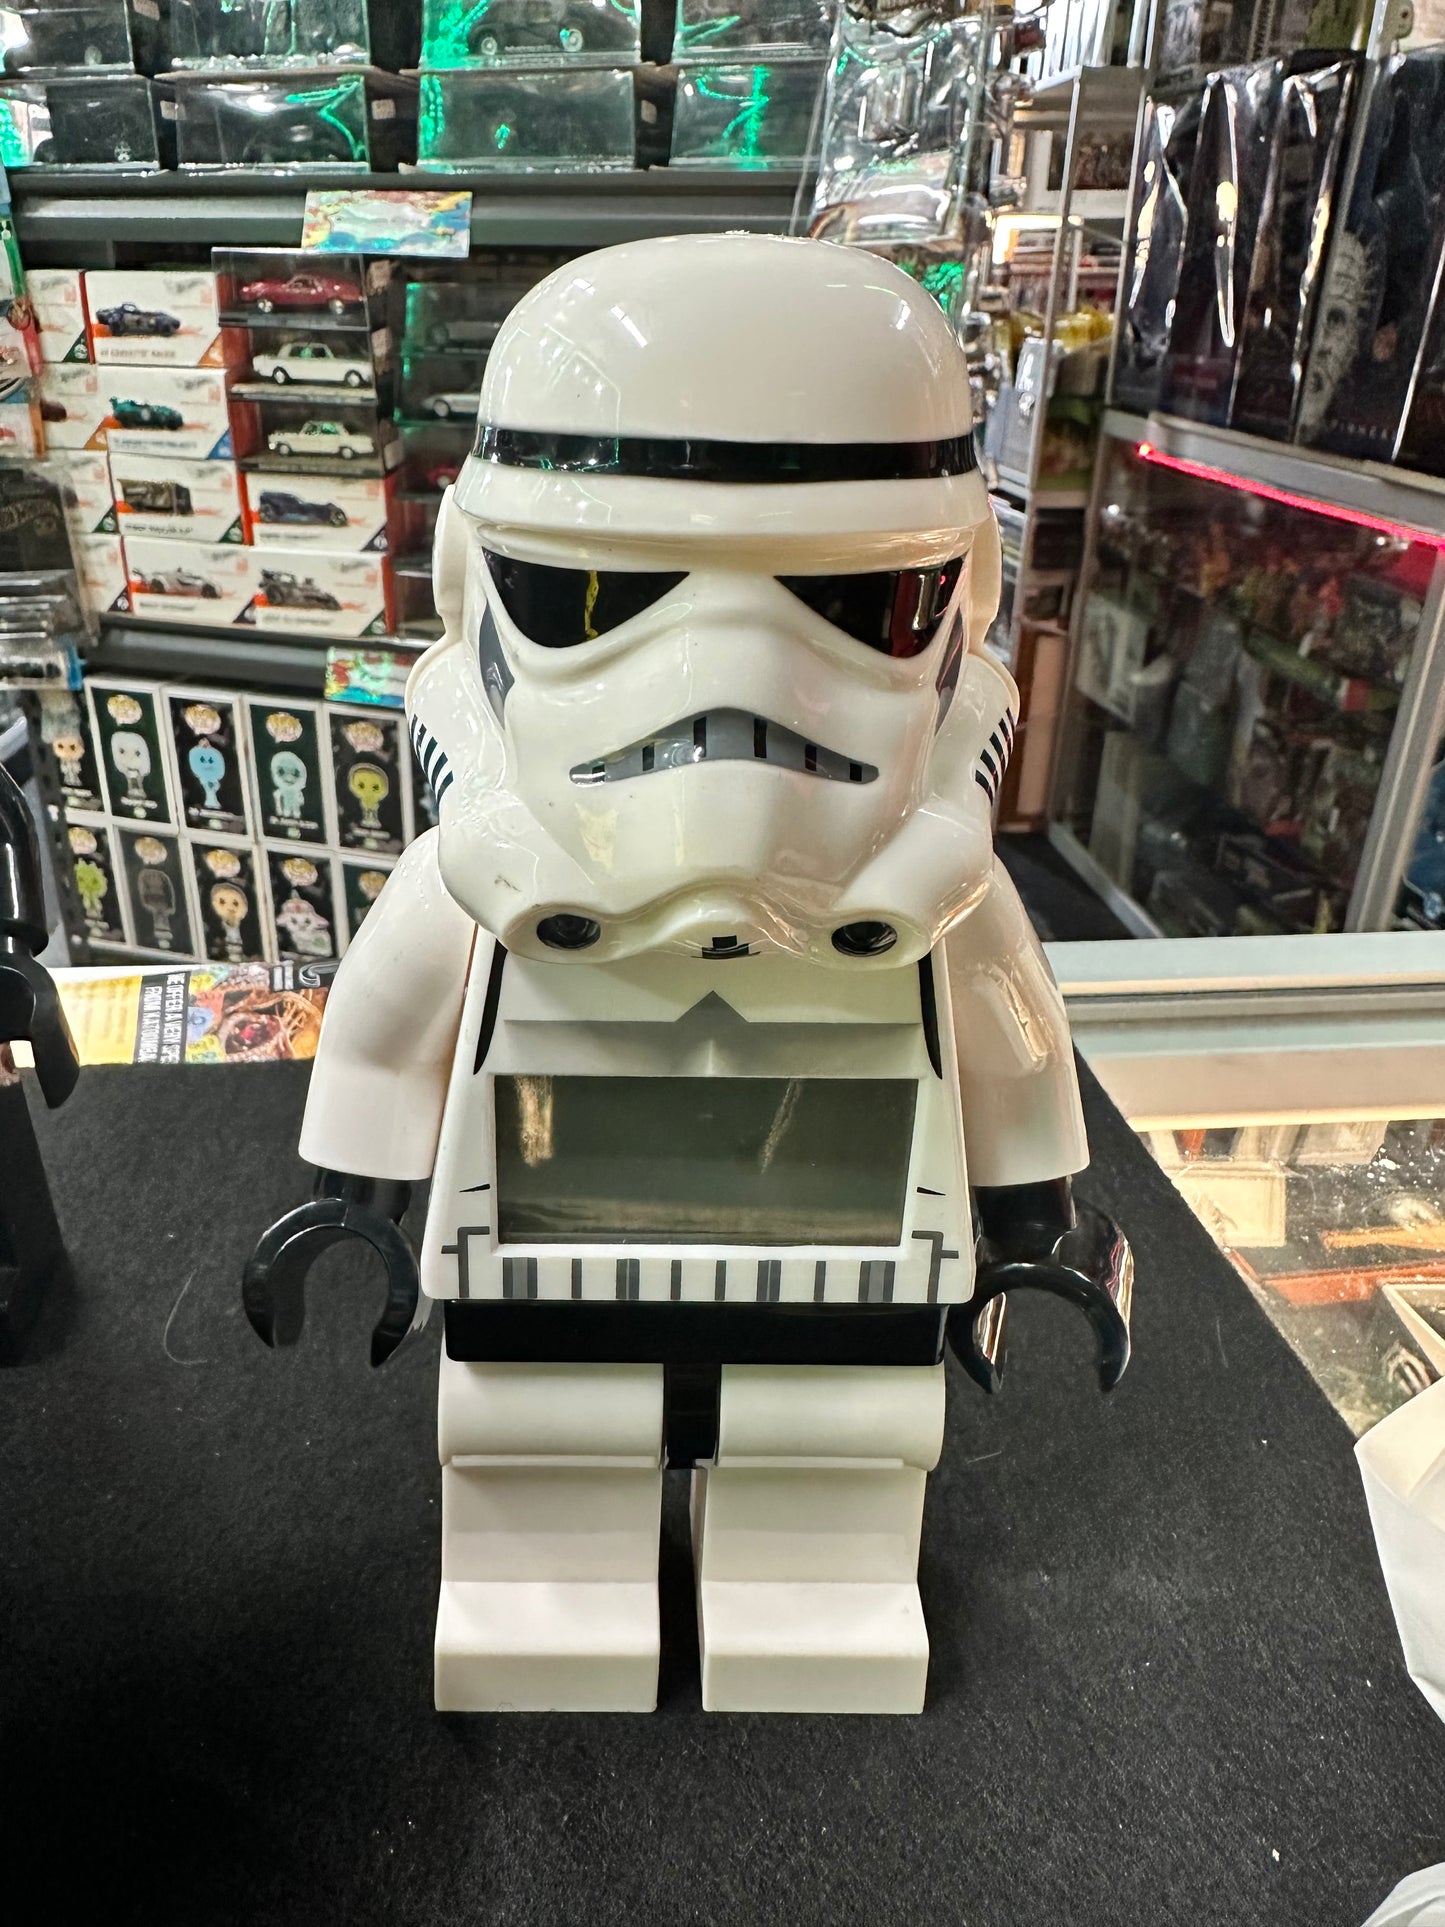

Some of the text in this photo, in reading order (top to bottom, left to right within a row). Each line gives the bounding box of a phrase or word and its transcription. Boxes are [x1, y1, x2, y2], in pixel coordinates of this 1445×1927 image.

[165, 985, 185, 1011] OFFER
[137, 985, 163, 1064] FROM KATOOMBA
[162, 1021, 182, 1044] VERY
